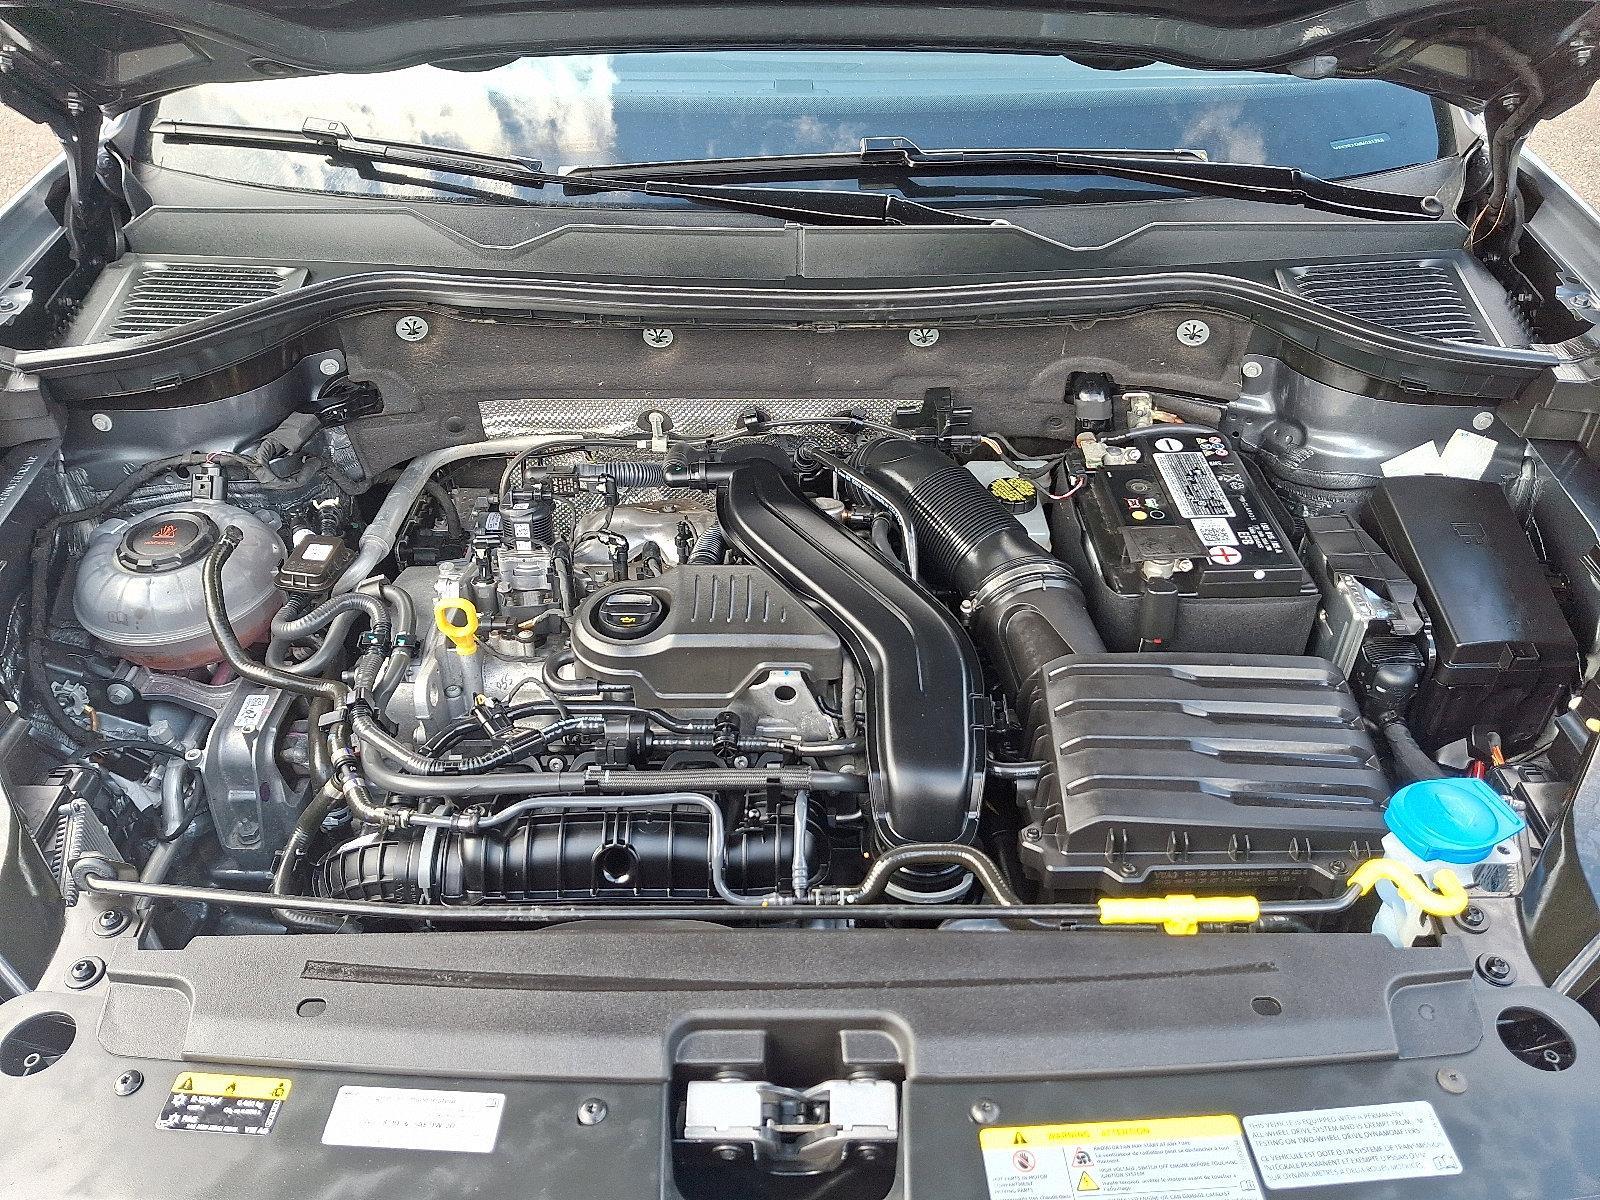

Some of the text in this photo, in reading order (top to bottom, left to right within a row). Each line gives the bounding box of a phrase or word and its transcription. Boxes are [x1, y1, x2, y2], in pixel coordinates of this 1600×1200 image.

[1237, 532, 1254, 545] EFB
[1300, 1116, 1337, 1124] EQUIPPED
[1311, 1125, 1339, 1133] SYSTEM
[1363, 1121, 1390, 1129] EXEMPT
[1254, 1138, 1284, 1147] TESTING
[1297, 1134, 1341, 1143] TWO-WHEEL
[1340, 1132, 1363, 1140] DRIVE
